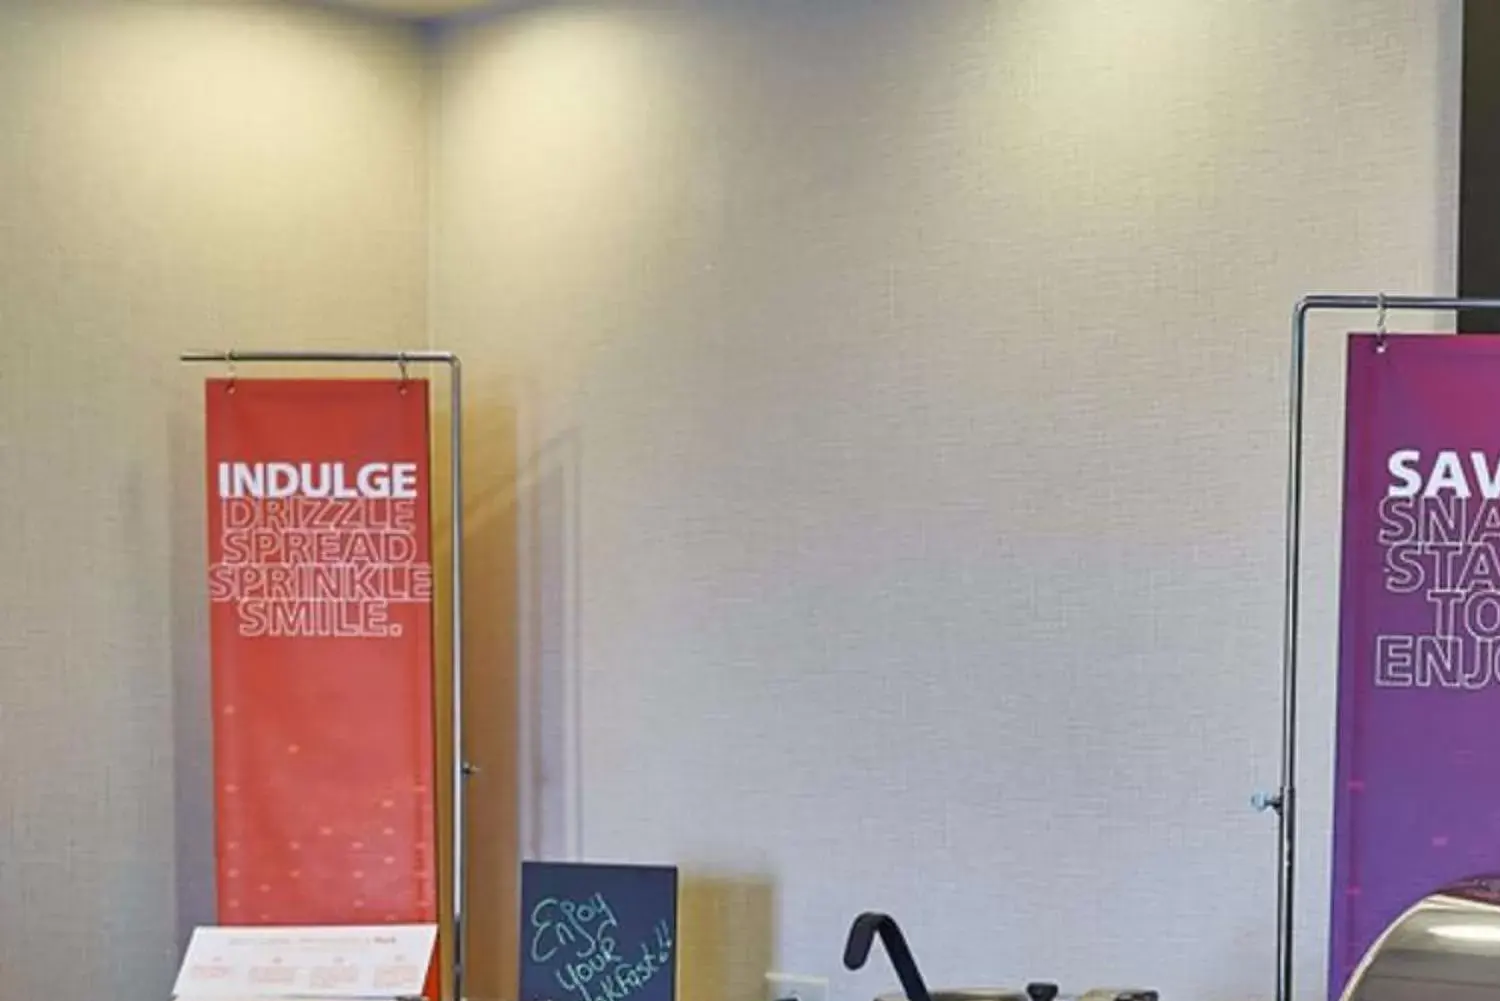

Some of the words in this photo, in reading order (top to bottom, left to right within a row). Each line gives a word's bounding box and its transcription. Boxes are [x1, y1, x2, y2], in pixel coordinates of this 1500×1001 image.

[217, 461, 418, 499] INDULGE
[221, 498, 416, 533] DRIZZLE
[221, 528, 418, 567] SPREAD
[206, 562, 434, 602] SPRINKLE
[239, 598, 403, 638] SMILE.
